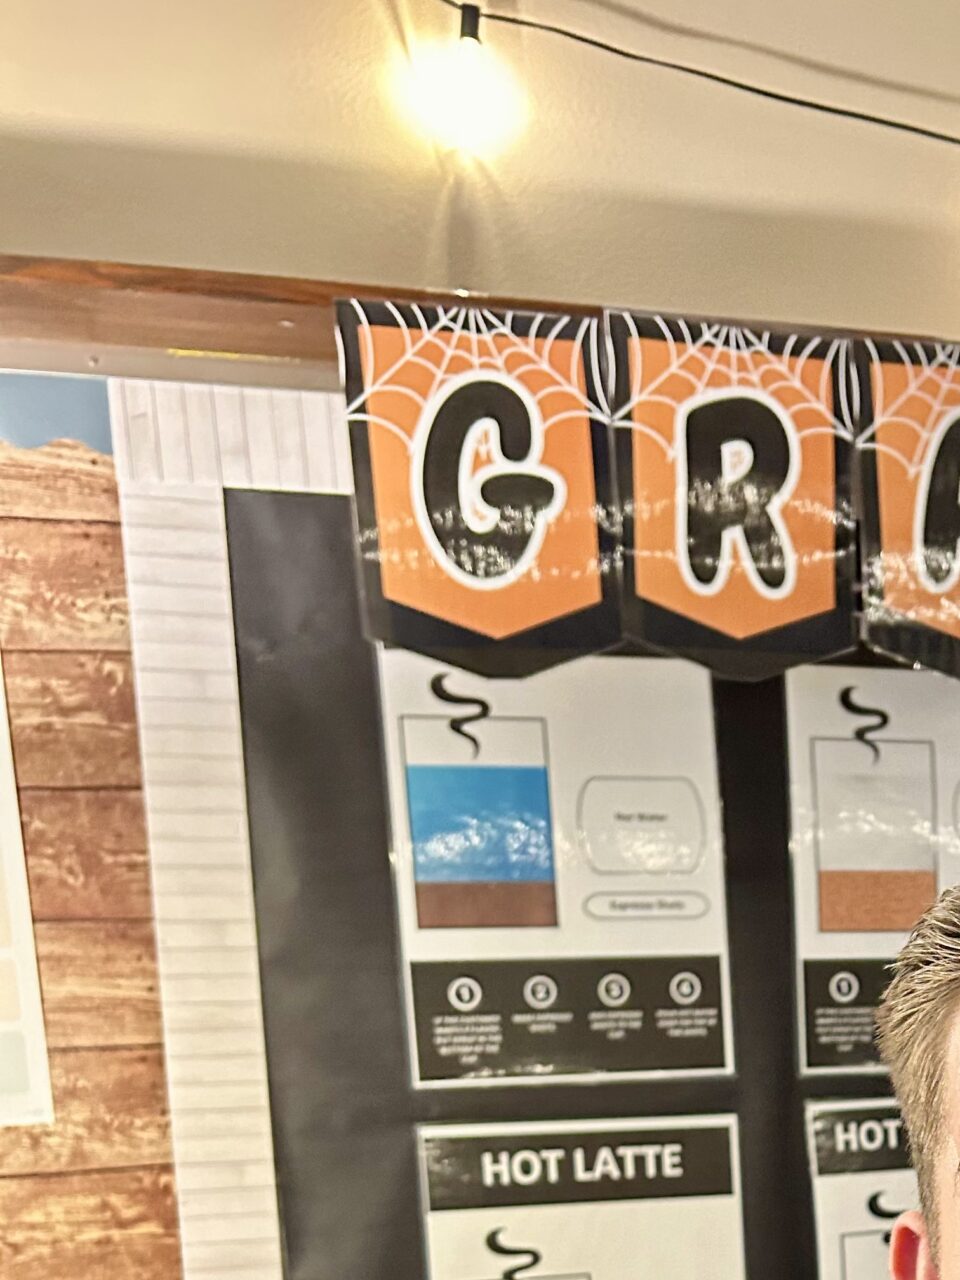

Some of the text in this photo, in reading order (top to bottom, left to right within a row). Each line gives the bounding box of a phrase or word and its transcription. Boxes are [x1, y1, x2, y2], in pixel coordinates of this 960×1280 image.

[834, 1118, 902, 1153] HOT
[481, 1143, 683, 1187] HOT LATTE
